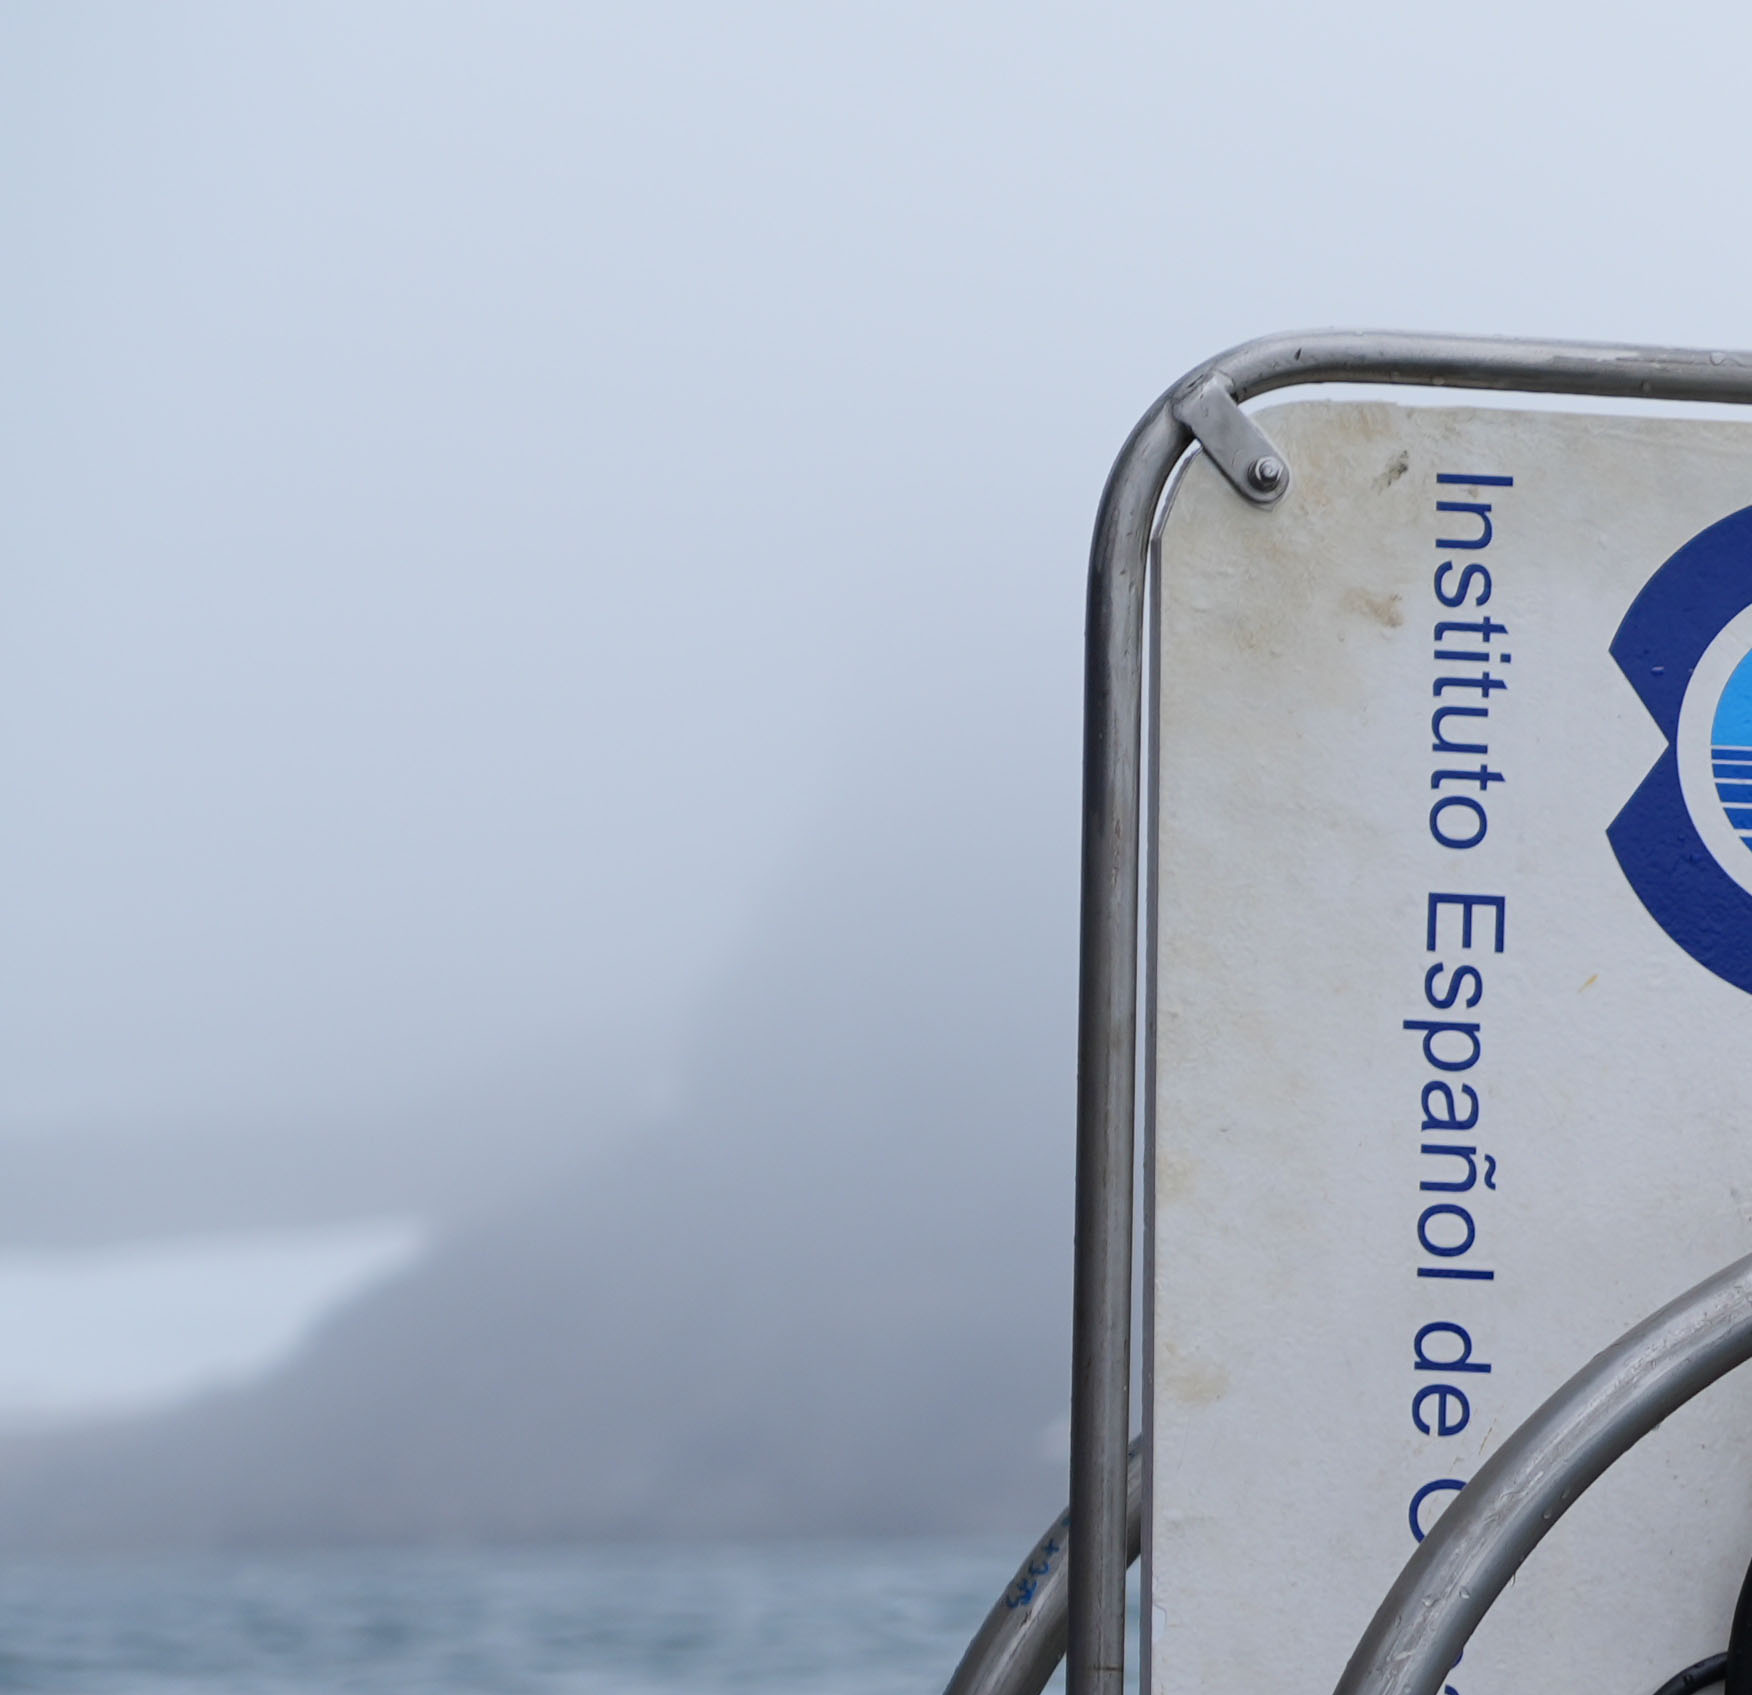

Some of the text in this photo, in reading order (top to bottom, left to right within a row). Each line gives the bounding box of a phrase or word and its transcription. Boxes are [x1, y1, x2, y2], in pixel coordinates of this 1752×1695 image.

[1431, 472, 1514, 850] Instituto
[1402, 891, 1506, 1281] Español
[1412, 1320, 1492, 1437] de
